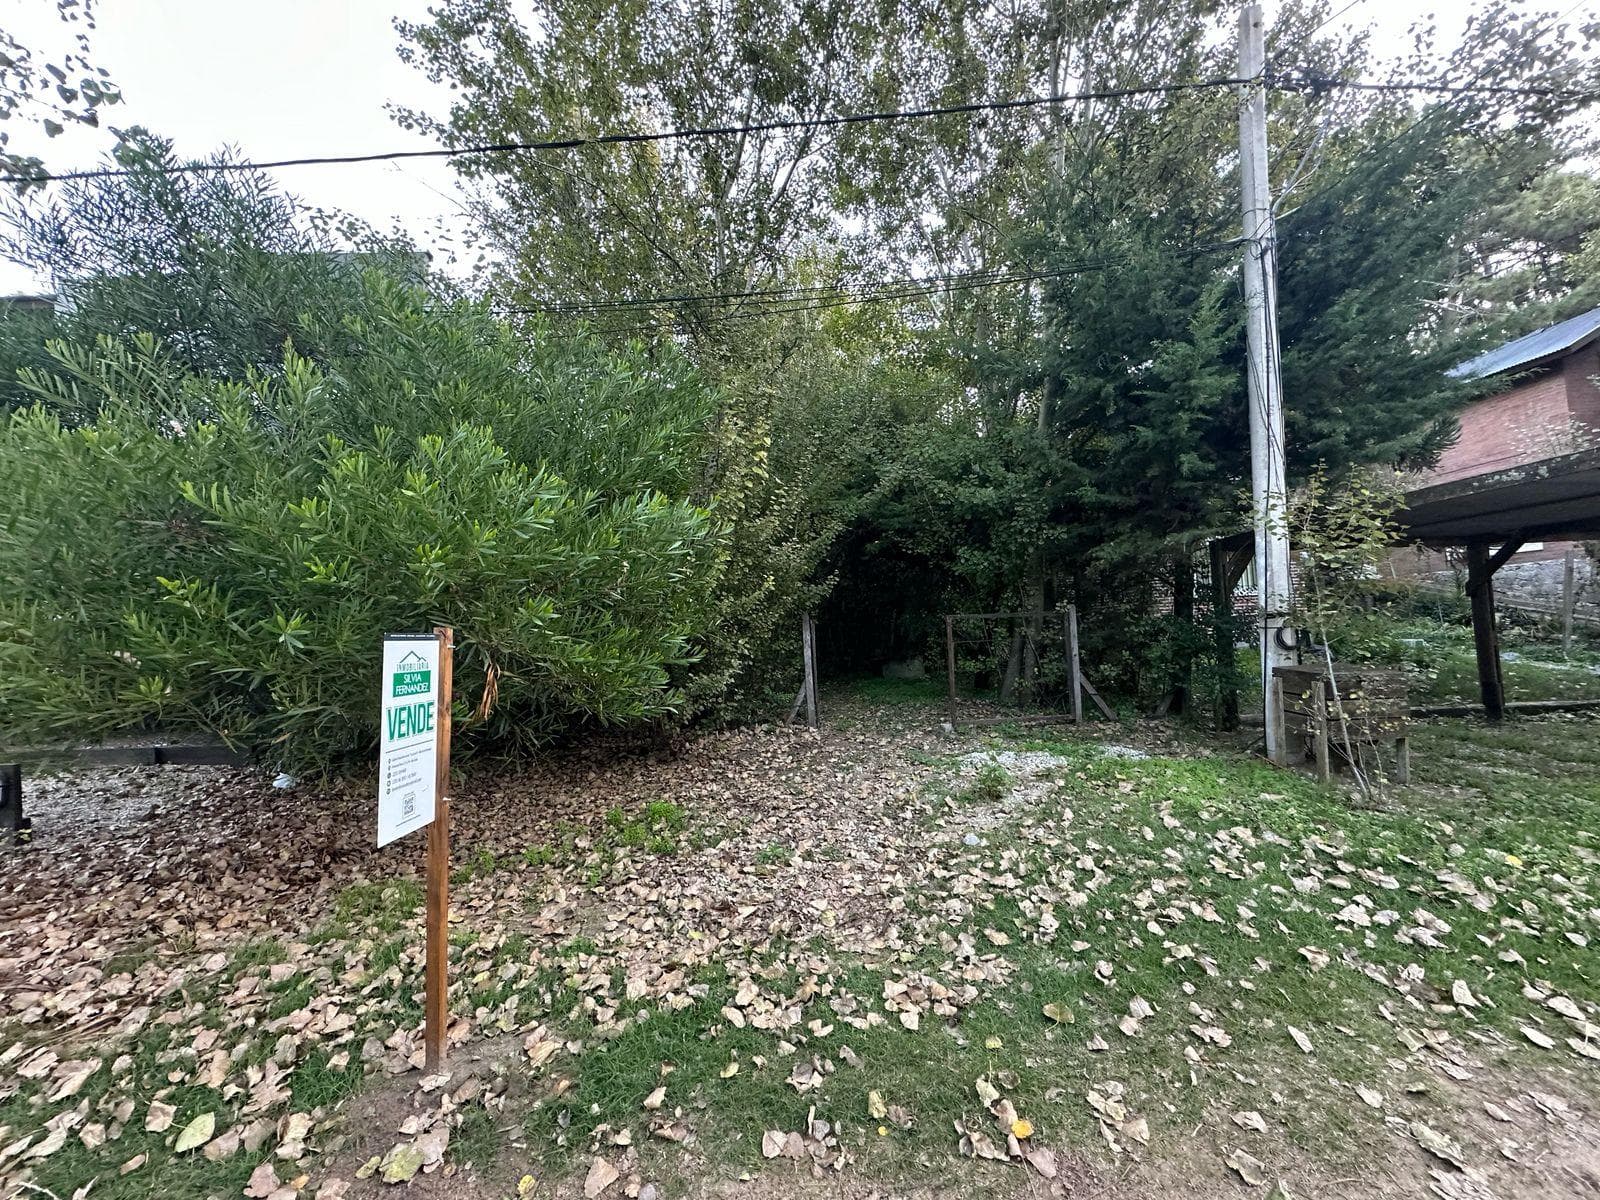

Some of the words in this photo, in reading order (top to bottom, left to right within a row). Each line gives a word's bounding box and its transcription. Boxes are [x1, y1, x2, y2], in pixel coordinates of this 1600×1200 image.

[403, 673, 422, 684] SILVIA
[395, 683, 429, 695] FERNANDEZ
[387, 701, 434, 741] VENDE
